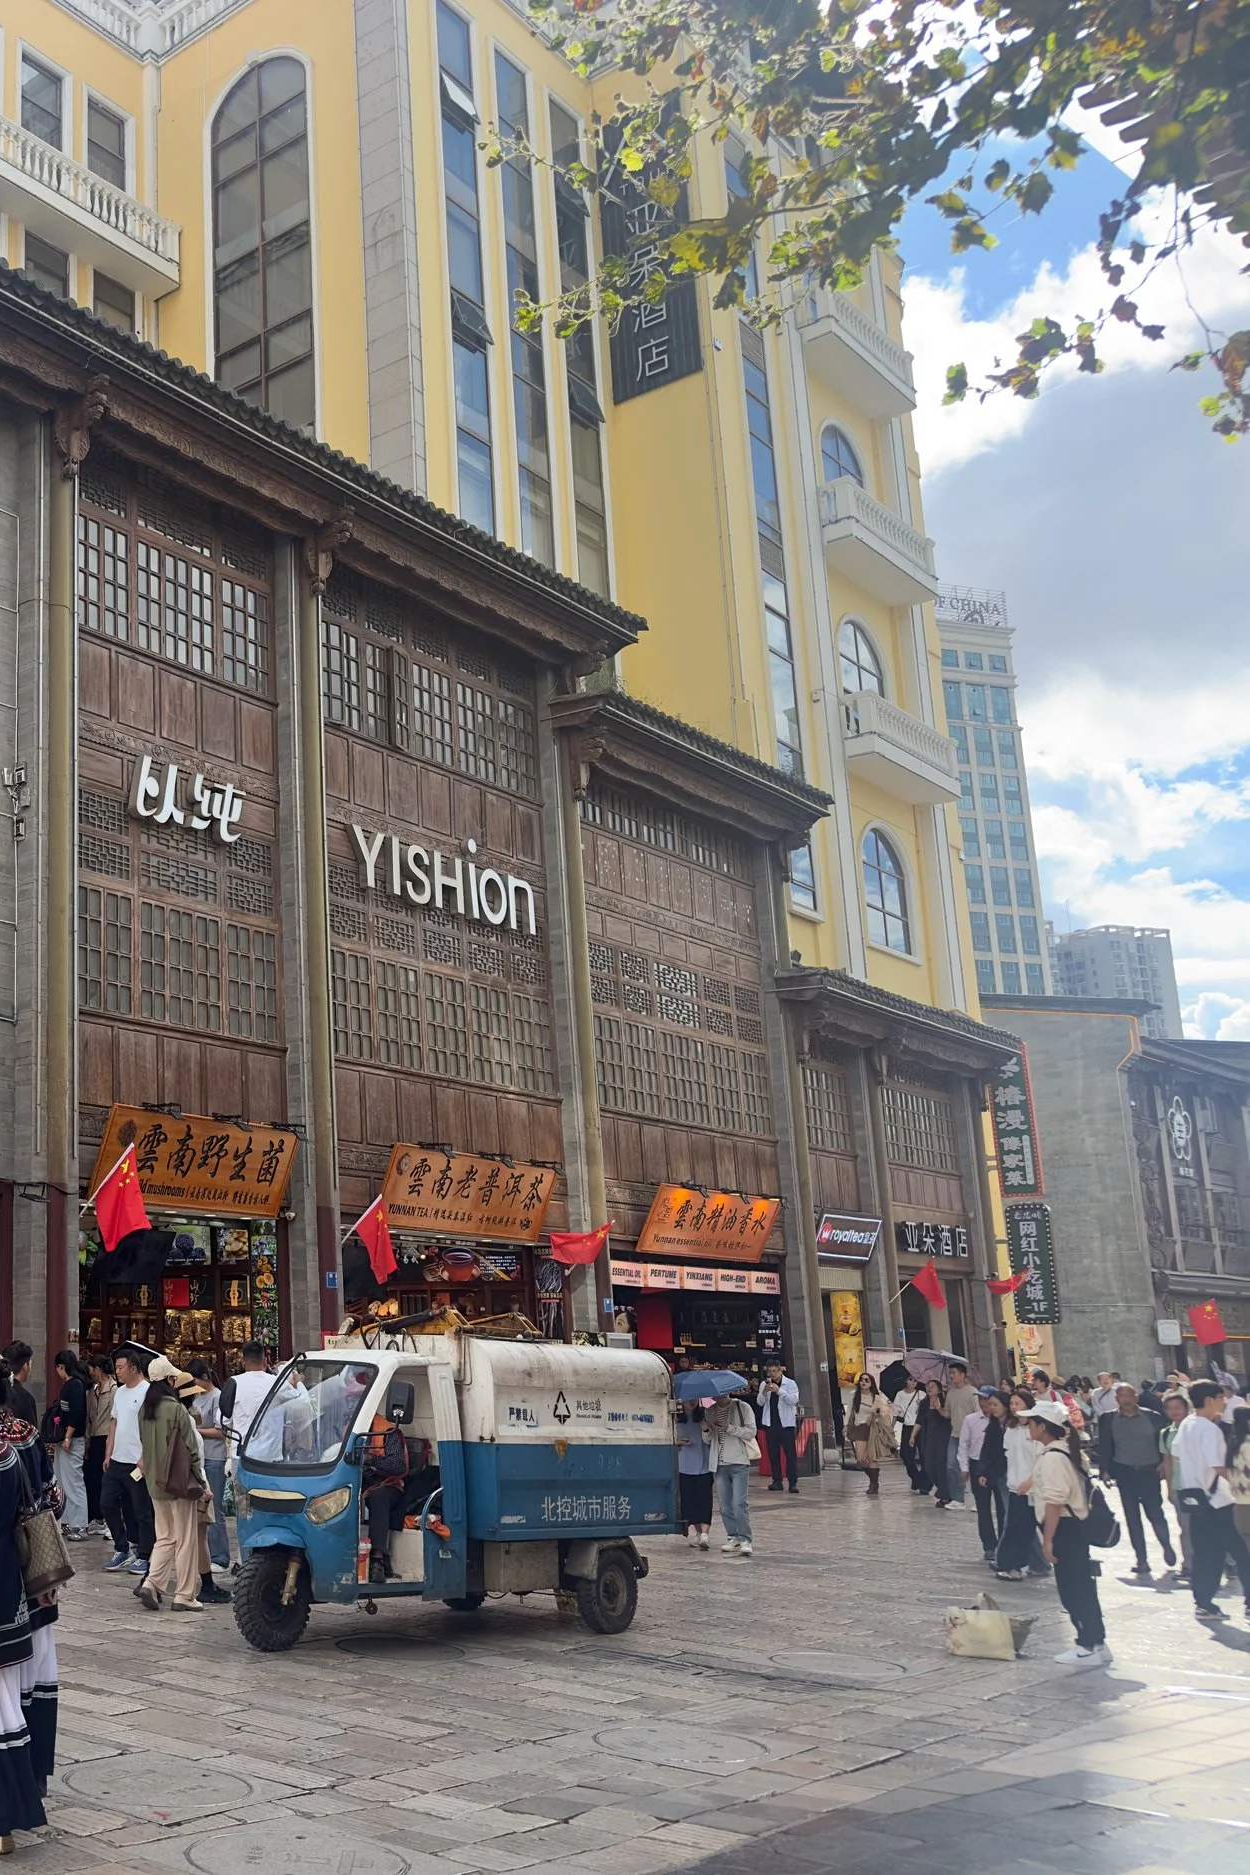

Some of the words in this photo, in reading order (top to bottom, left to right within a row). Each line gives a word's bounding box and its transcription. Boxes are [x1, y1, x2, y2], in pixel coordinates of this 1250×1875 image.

[950, 597, 1000, 615] CHINA
[136, 1123, 285, 1187] 雲南野生菌
[147, 1181, 186, 1198] mushrooms
[408, 1158, 545, 1211] 雲南老普洱茶
[388, 1203, 416, 1217] YUNNAN
[416, 1206, 429, 1218] TEA
[673, 1199, 768, 1236] 雲南精油香水
[653, 1233, 676, 1244] Yunnan
[676, 1236, 703, 1247] essential
[703, 1238, 713, 1248] oil
[829, 1228, 864, 1244] royaltea
[904, 1221, 969, 1258] 亚朵酒店
[1019, 1221, 1044, 1301] 网红小吃城
[612, 1267, 633, 1278] ESSENTIAL
[634, 1270, 642, 1279] OIL
[686, 1271, 713, 1282] YINXIANG
[720, 1274, 747, 1284] HIGH-END
[755, 1276, 776, 1285] AROMA
[1024, 1302, 1049, 1312] -1F
[508, 1406, 535, 1422] 严禁载人
[576, 1400, 602, 1412] 其他垃圾
[541, 1495, 632, 1522] 北控城市服务
